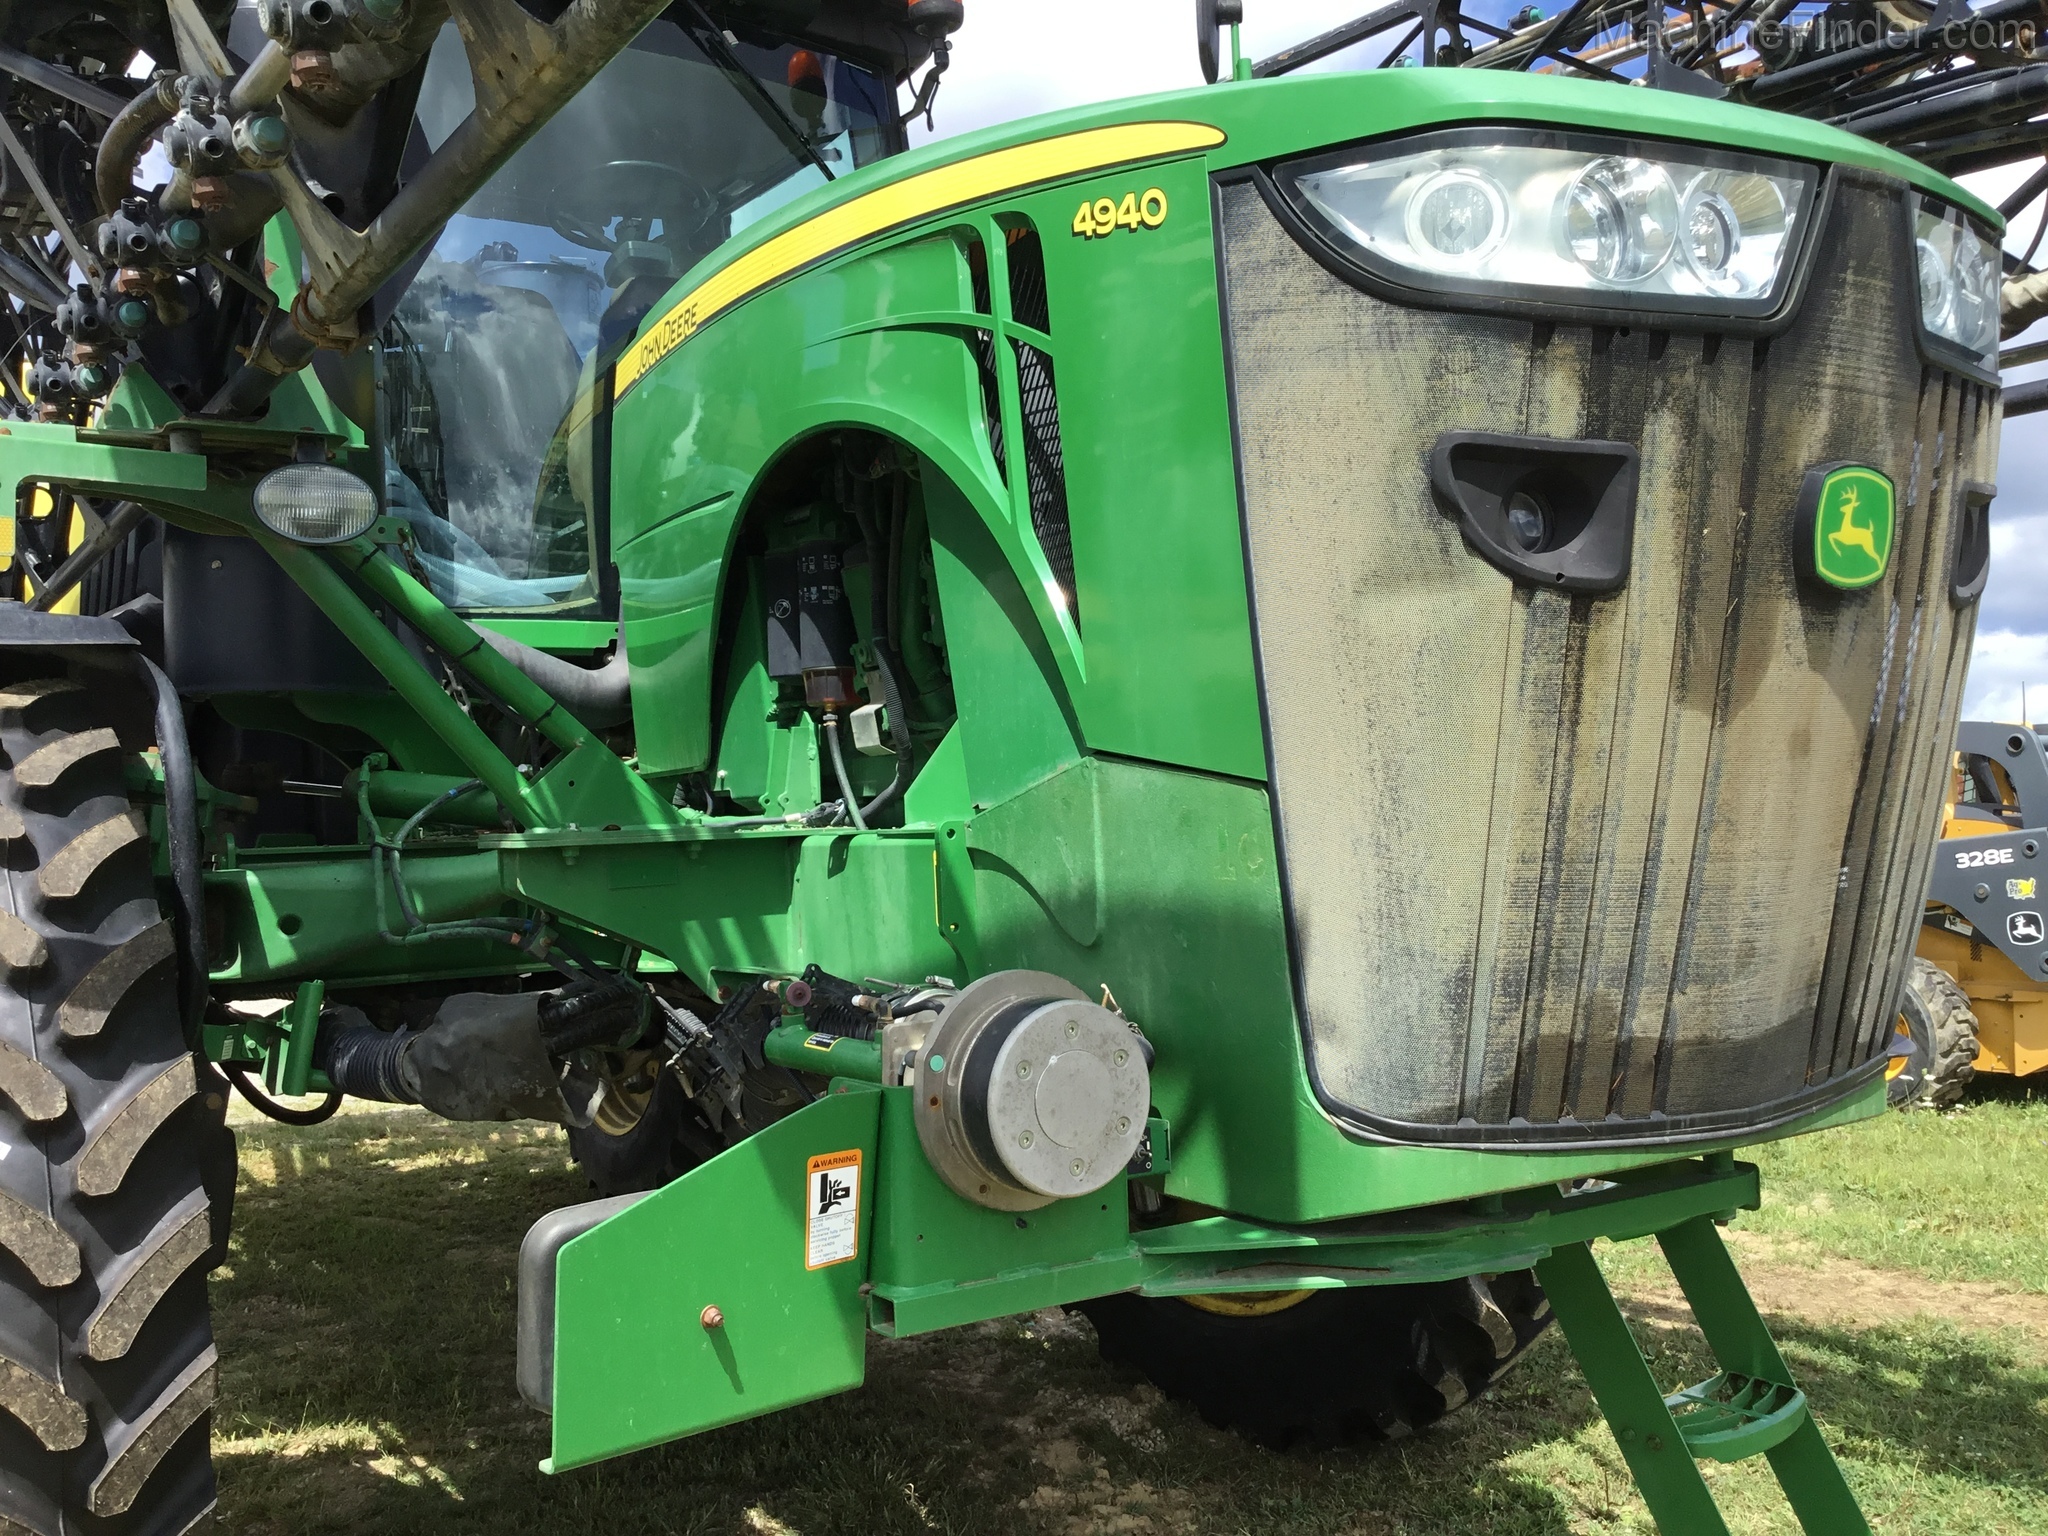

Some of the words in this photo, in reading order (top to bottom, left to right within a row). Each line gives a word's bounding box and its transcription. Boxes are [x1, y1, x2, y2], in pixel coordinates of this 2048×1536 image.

[1071, 186, 1168, 241] 4940
[636, 332, 661, 377] JOHN
[662, 302, 698, 351] DEERE
[1954, 848, 2015, 869] 328E
[820, 1154, 858, 1167] WARNING
